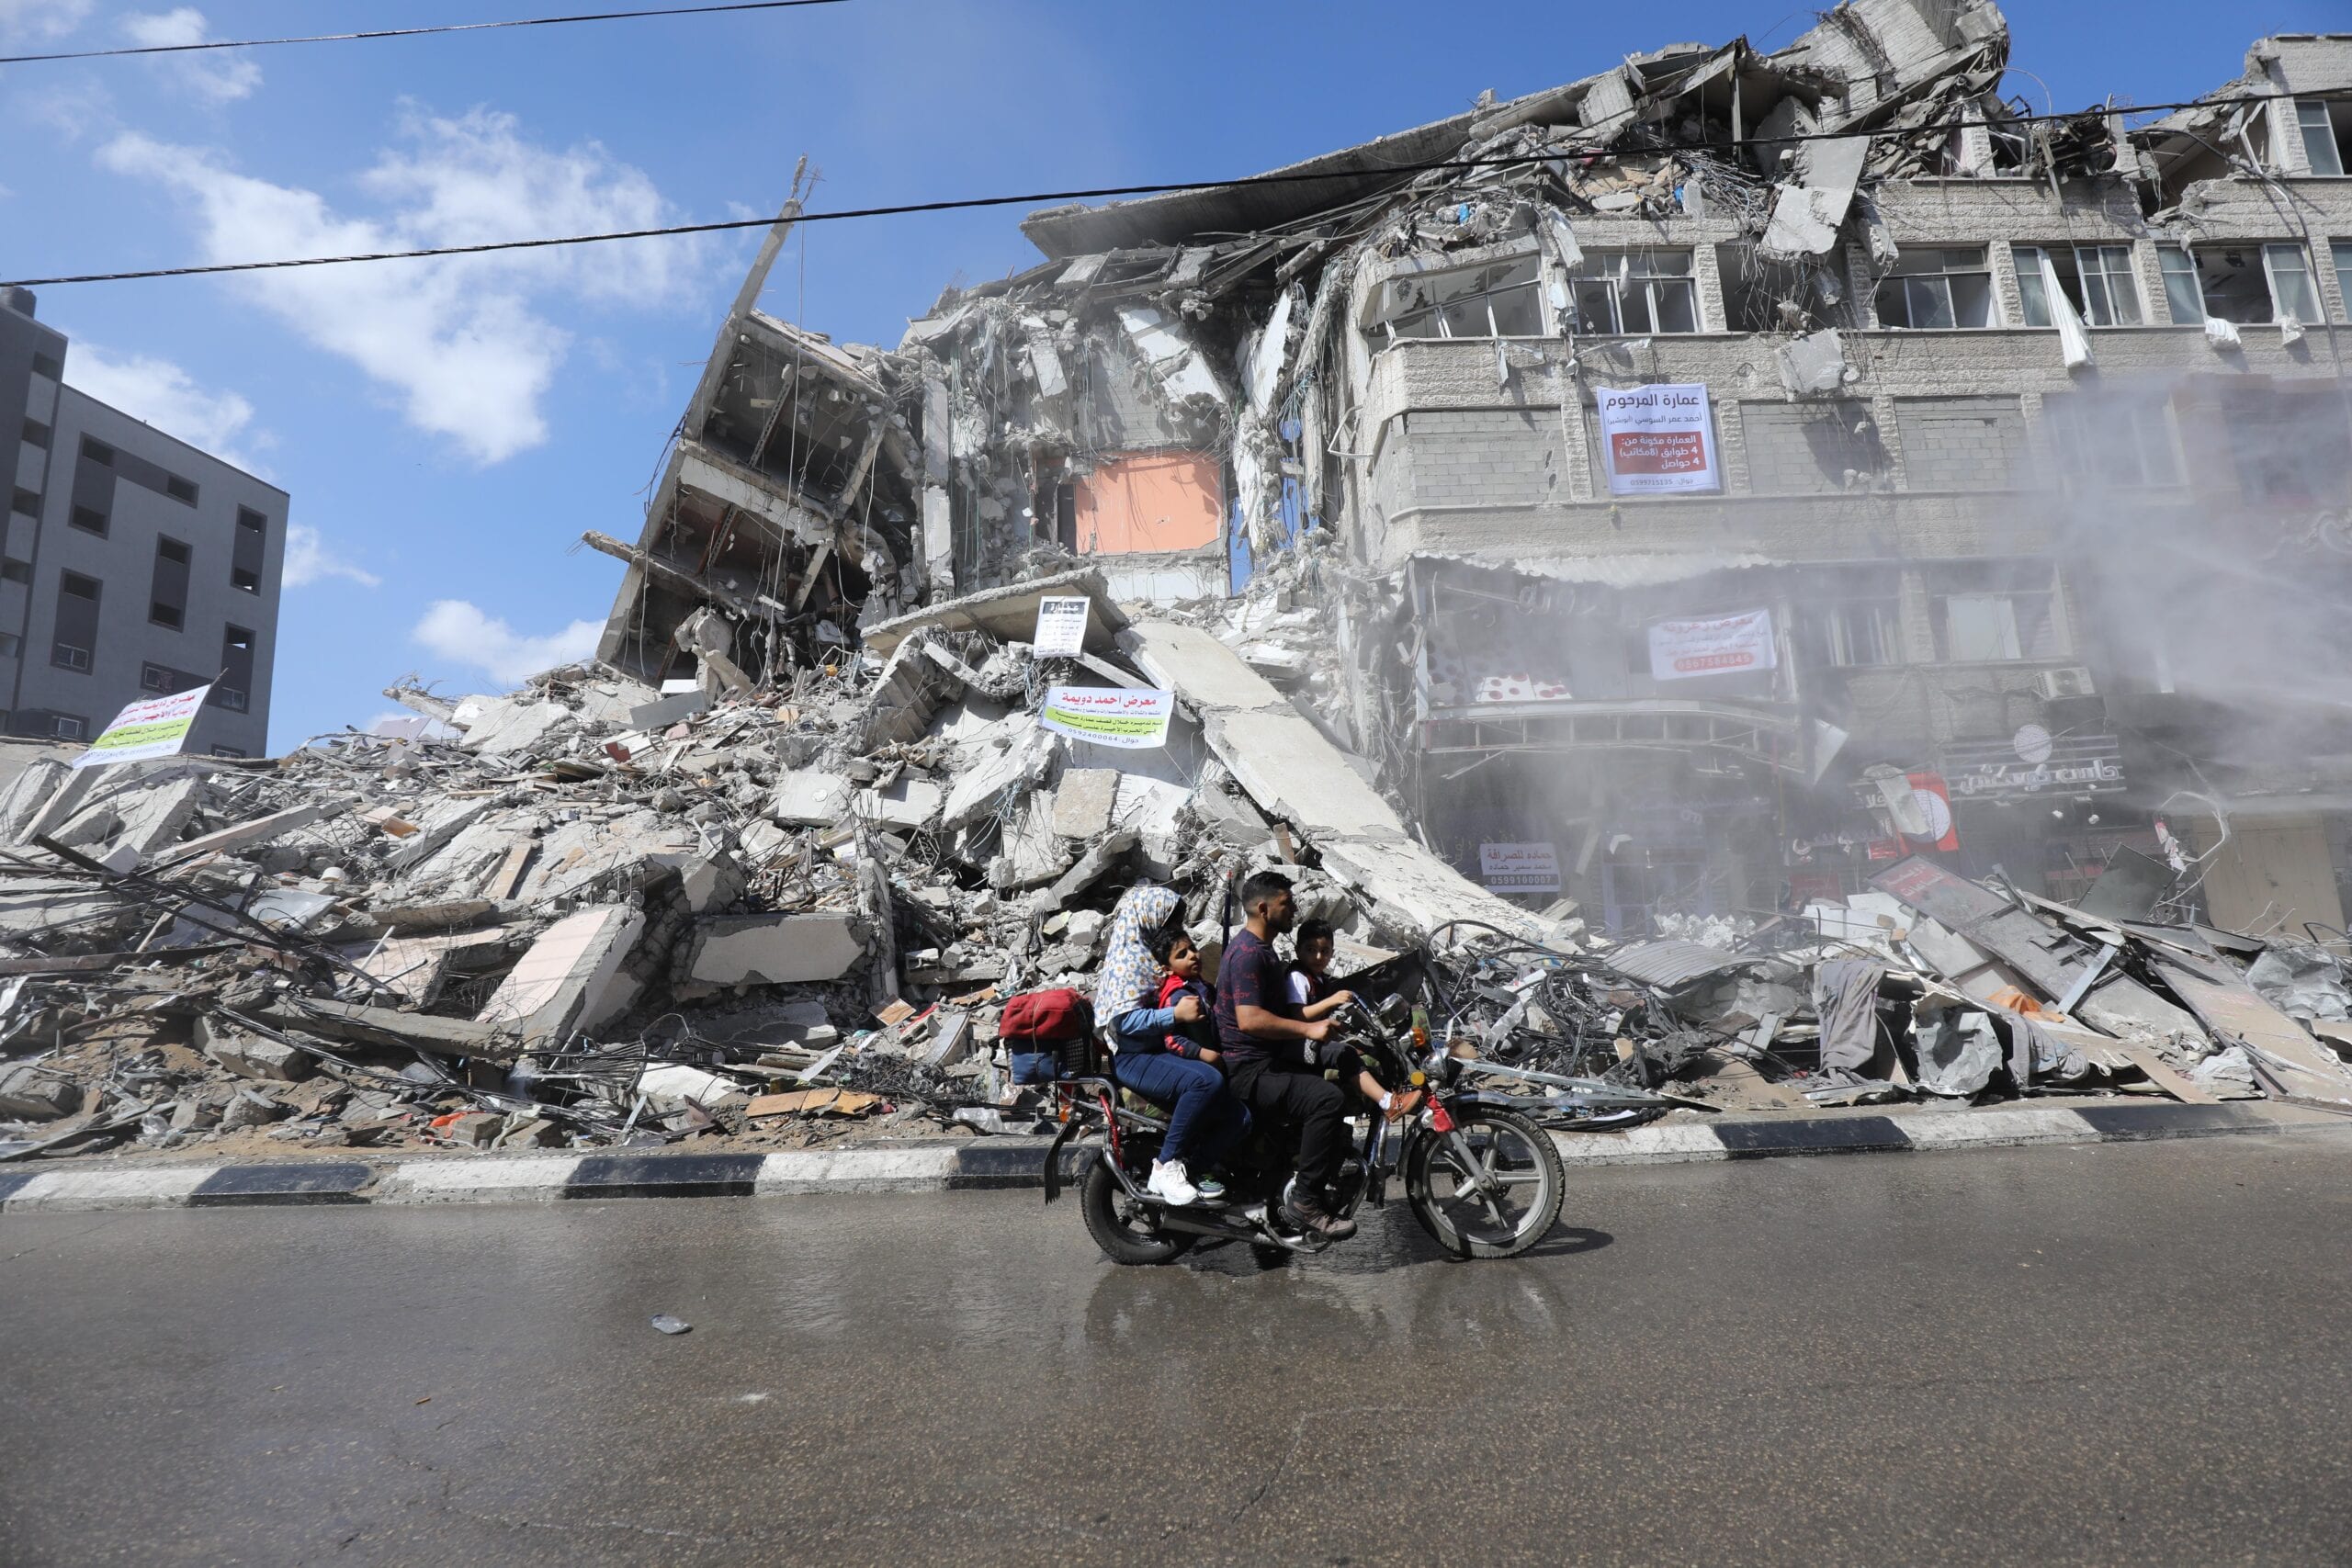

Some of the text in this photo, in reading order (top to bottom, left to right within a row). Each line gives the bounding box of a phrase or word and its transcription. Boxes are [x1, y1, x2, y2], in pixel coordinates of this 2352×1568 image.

[1606, 393, 1700, 411] عمارة المرحوم
[1634, 415, 1666, 426] السوسي
[1668, 416, 1682, 424] عمر
[1639, 435, 1665, 446] مكونة
[1667, 434, 1696, 446] العمارة
[1660, 446, 1690, 458] طوابق
[1690, 446, 1698, 454] 4
[1661, 457, 1701, 470] 4 حواصل
[1062, 692, 1092, 705] دويمة
[1124, 695, 1157, 708] معرض
[1068, 728, 1118, 741] 0592400064
[1487, 848, 1524, 862] للصرافة
[1490, 875, 1552, 885] 0599100007
